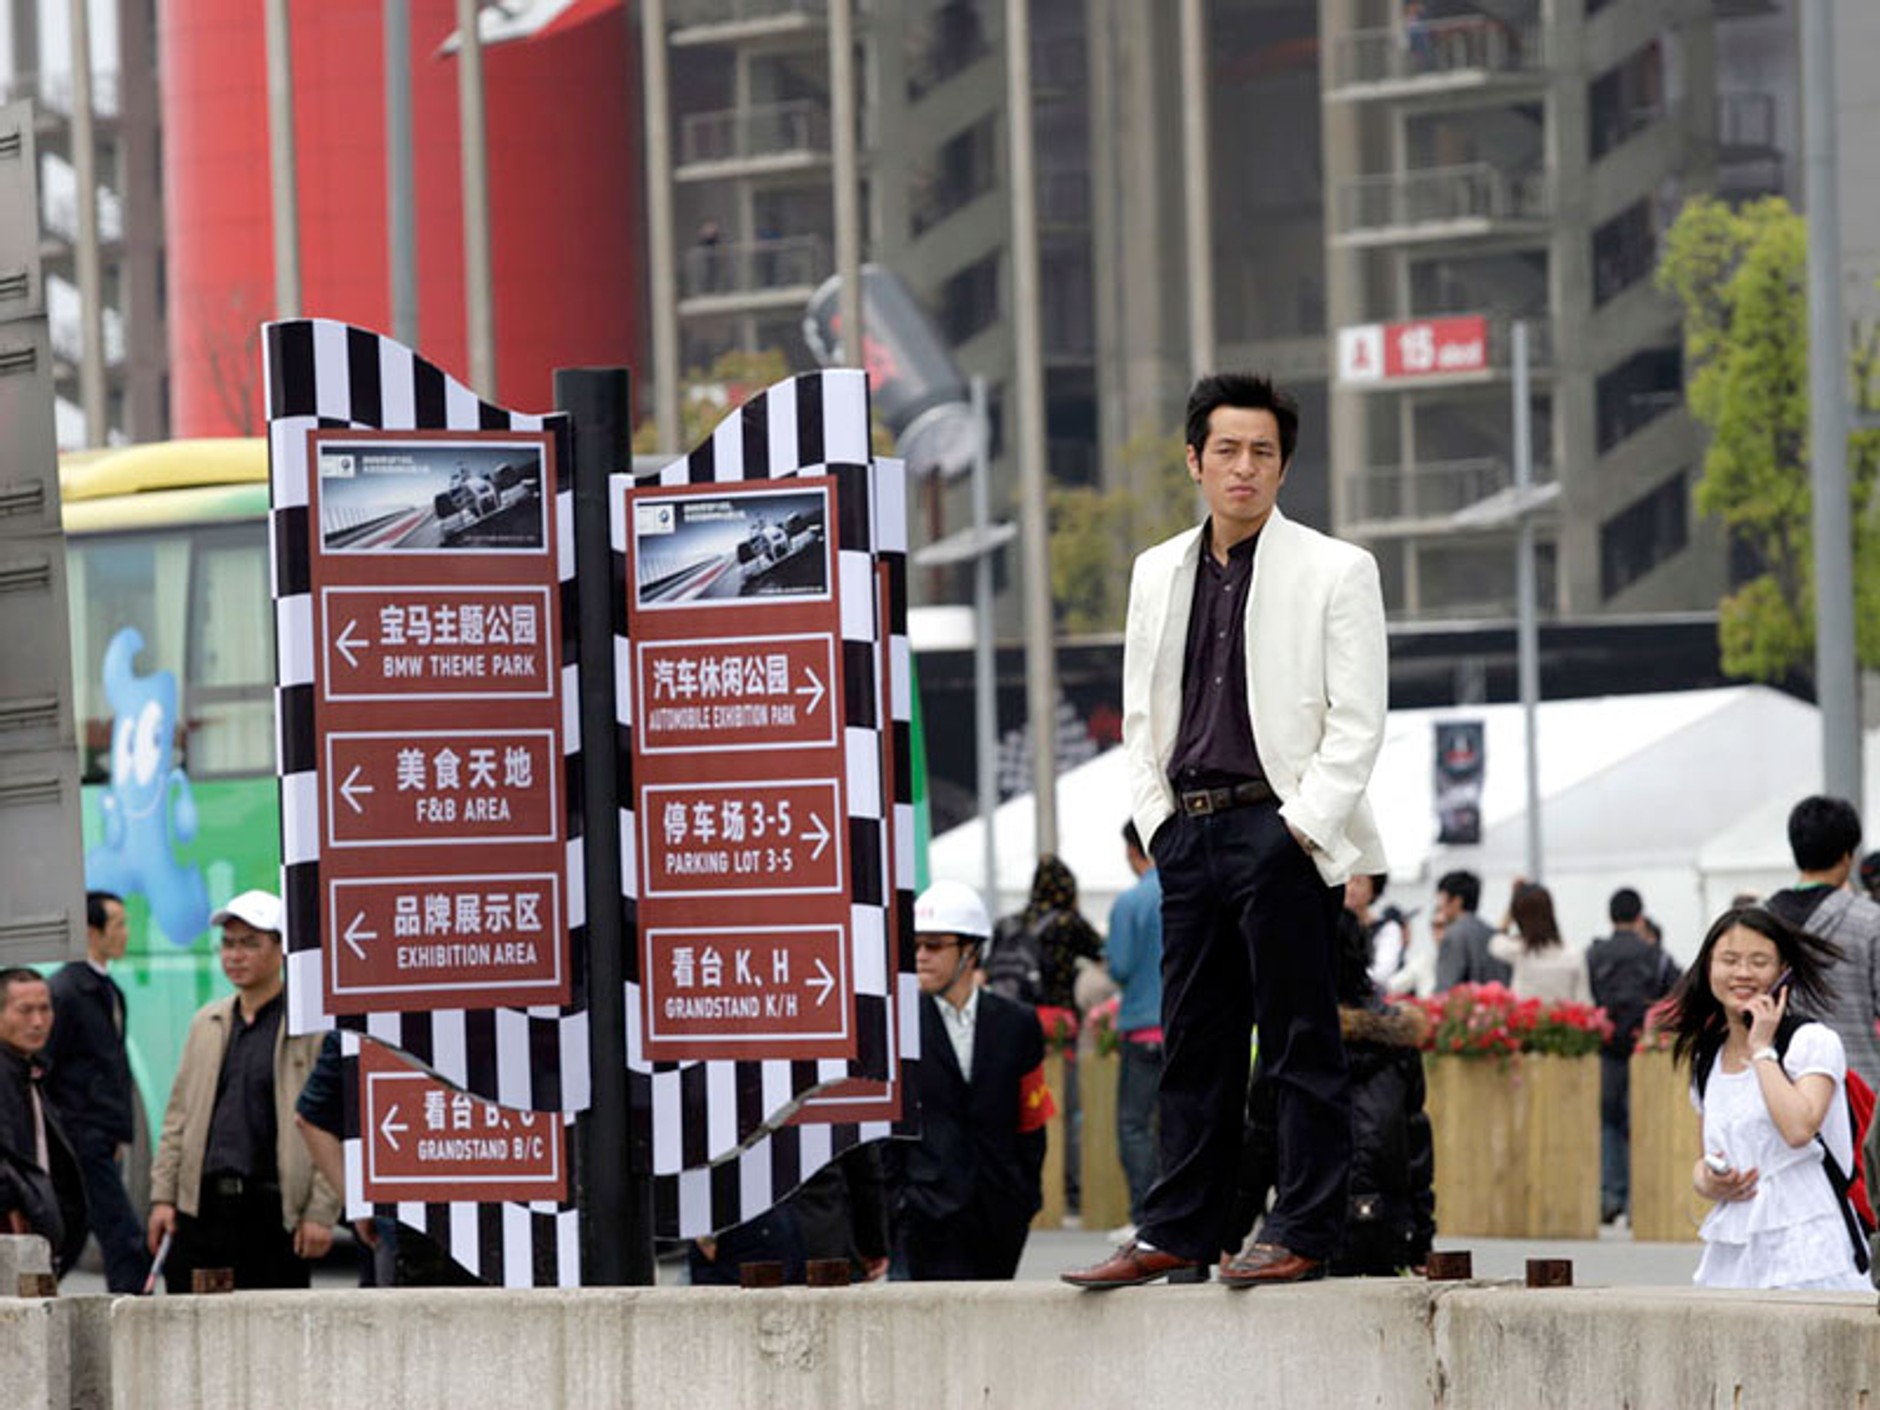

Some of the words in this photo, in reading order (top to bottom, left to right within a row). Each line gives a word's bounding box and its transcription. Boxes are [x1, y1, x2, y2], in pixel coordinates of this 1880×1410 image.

[379, 603, 537, 645] 宝马主题公园
[382, 655, 423, 677] BMW
[429, 654, 486, 676] THEME
[492, 654, 536, 675] PARK
[652, 653, 789, 700] 汽车休闲公园
[770, 703, 797, 726] PARK
[396, 746, 532, 791] 美食天地
[416, 800, 457, 822] F&B
[463, 797, 511, 821] AREA
[664, 851, 729, 874] PARKING
[733, 850, 761, 872] LOT
[766, 848, 793, 872] 3-5
[393, 892, 542, 937] 品牌展示区
[396, 944, 490, 969] EXHIBITION
[493, 942, 537, 965] AREA
[665, 996, 760, 1018] GRANDSTAND
[764, 994, 798, 1016] K/H
[417, 1138, 508, 1161] GRANDSTAND
[512, 1136, 543, 1161] B/C
